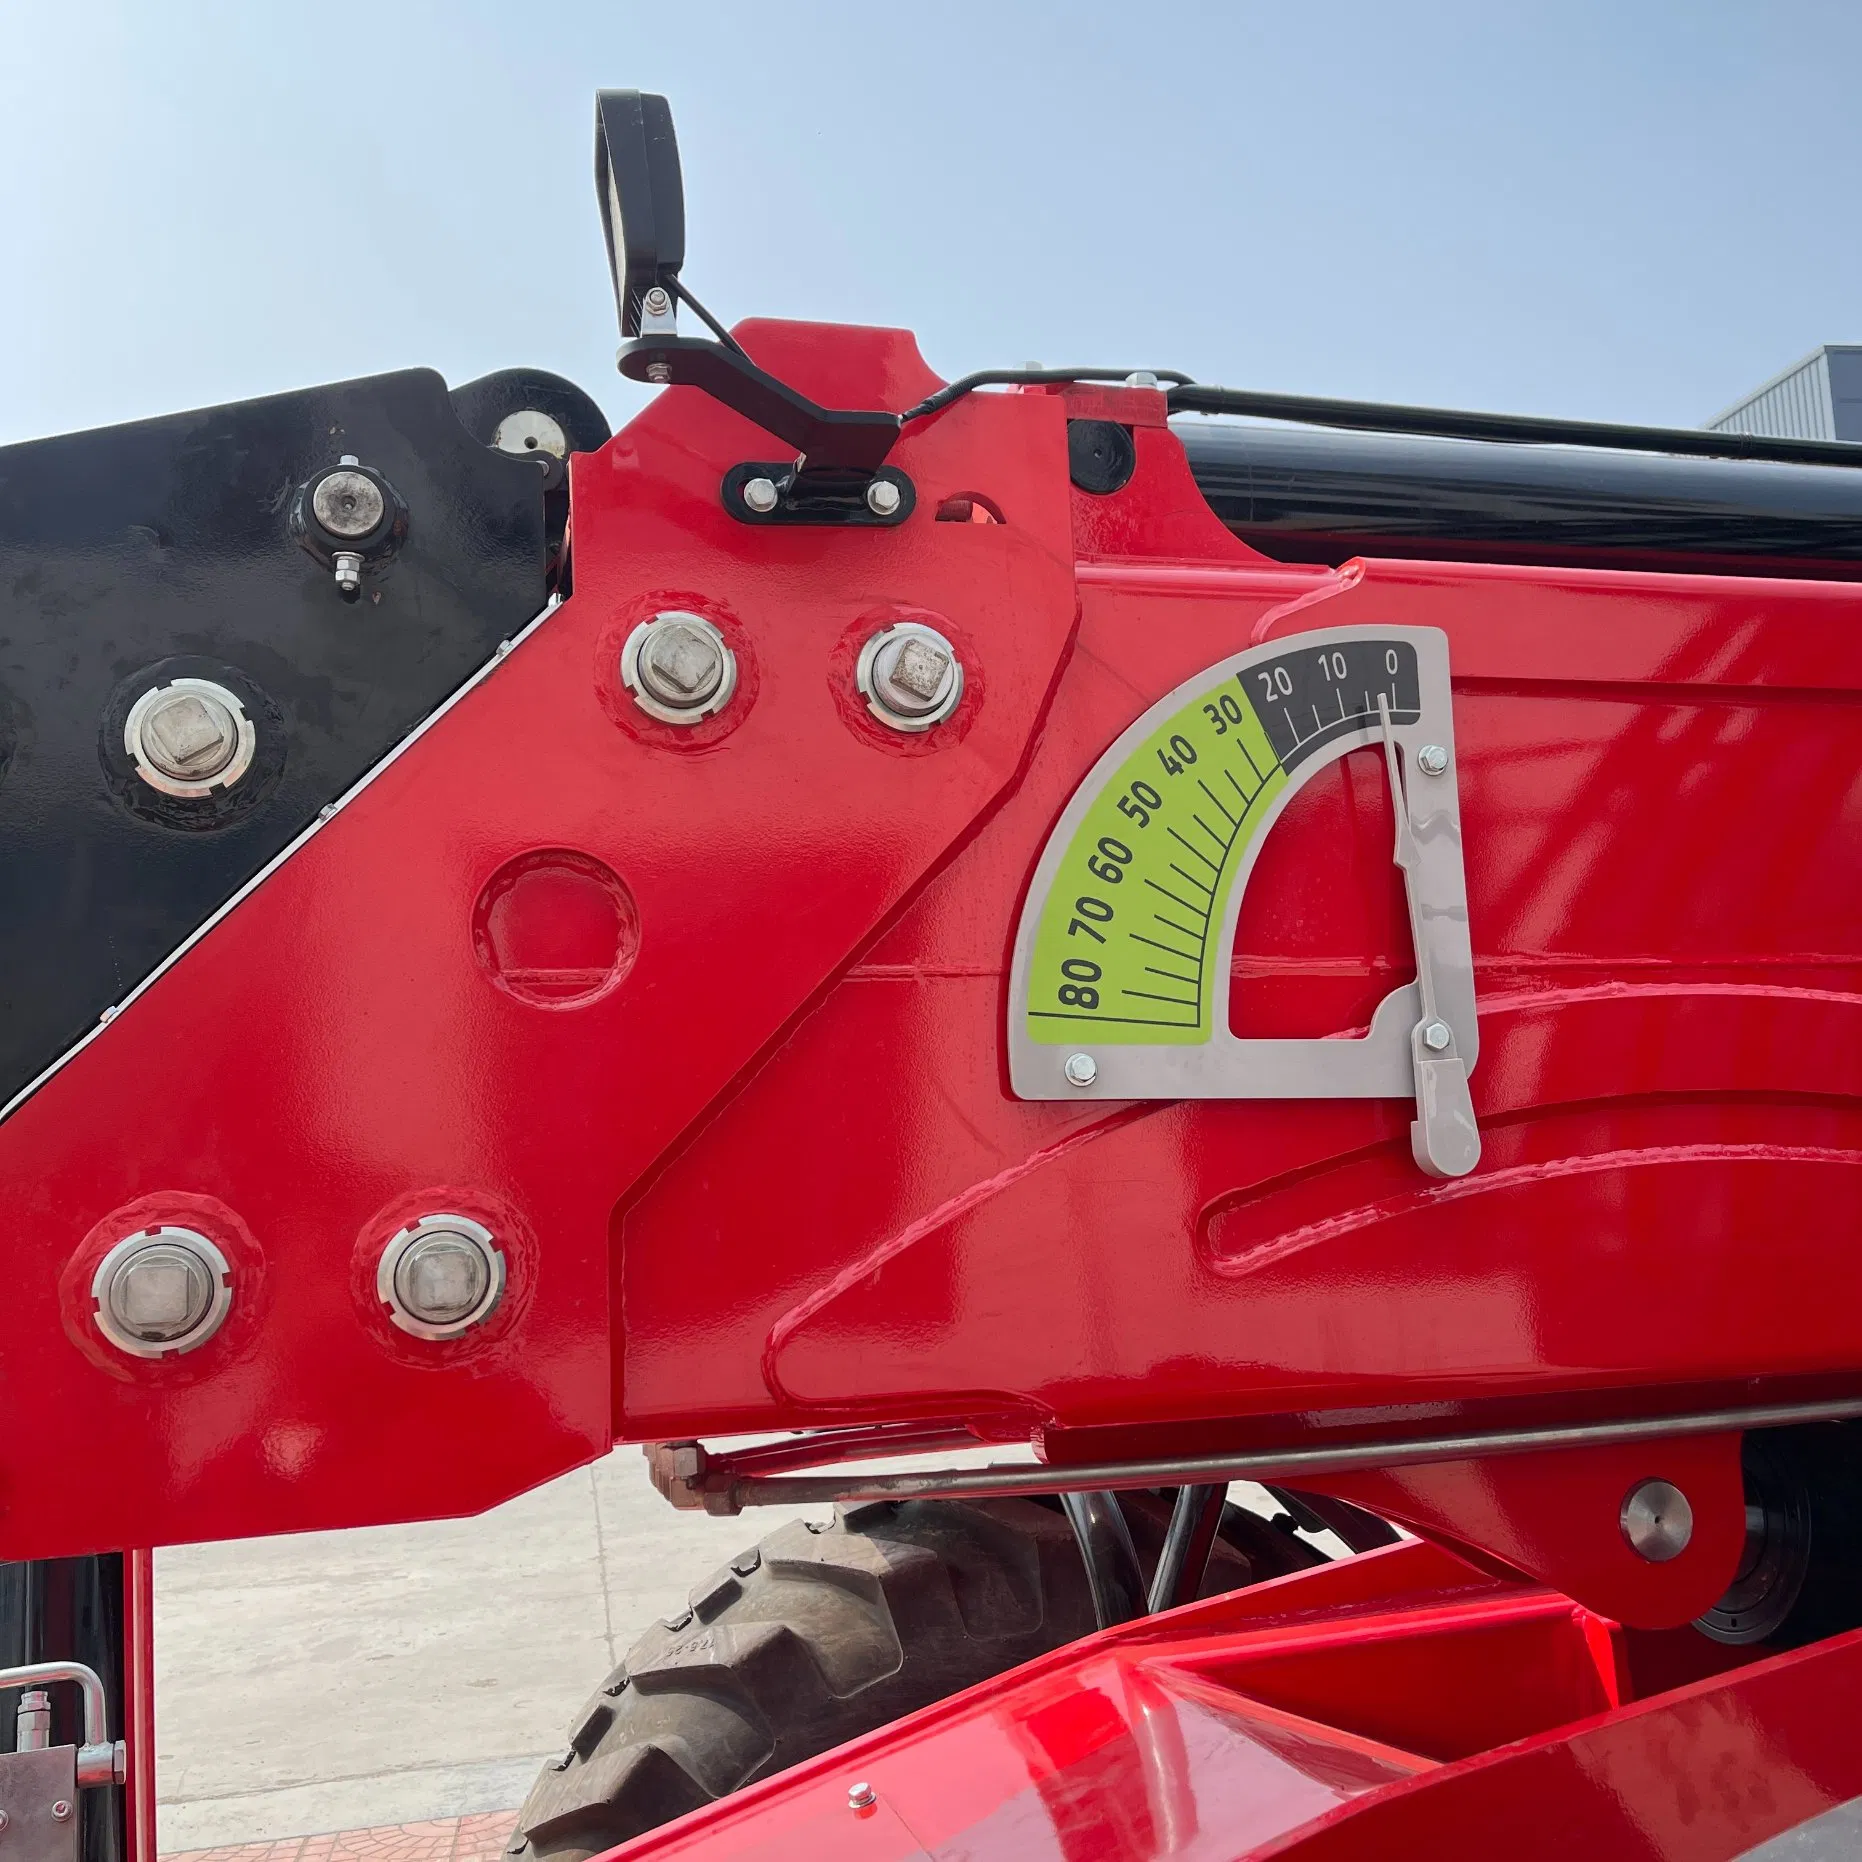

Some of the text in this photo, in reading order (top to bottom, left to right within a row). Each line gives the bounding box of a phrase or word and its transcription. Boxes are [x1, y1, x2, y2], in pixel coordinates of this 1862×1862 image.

[1317, 651, 1348, 682] 10
[1386, 649, 1398, 675] 0
[1257, 667, 1293, 702] 20
[1202, 694, 1243, 735] 30
[1156, 734, 1198, 777] 40
[1116, 780, 1163, 829] 50
[1087, 836, 1133, 884] 60
[1067, 896, 1114, 945] 70
[1057, 958, 1103, 1010] 80
